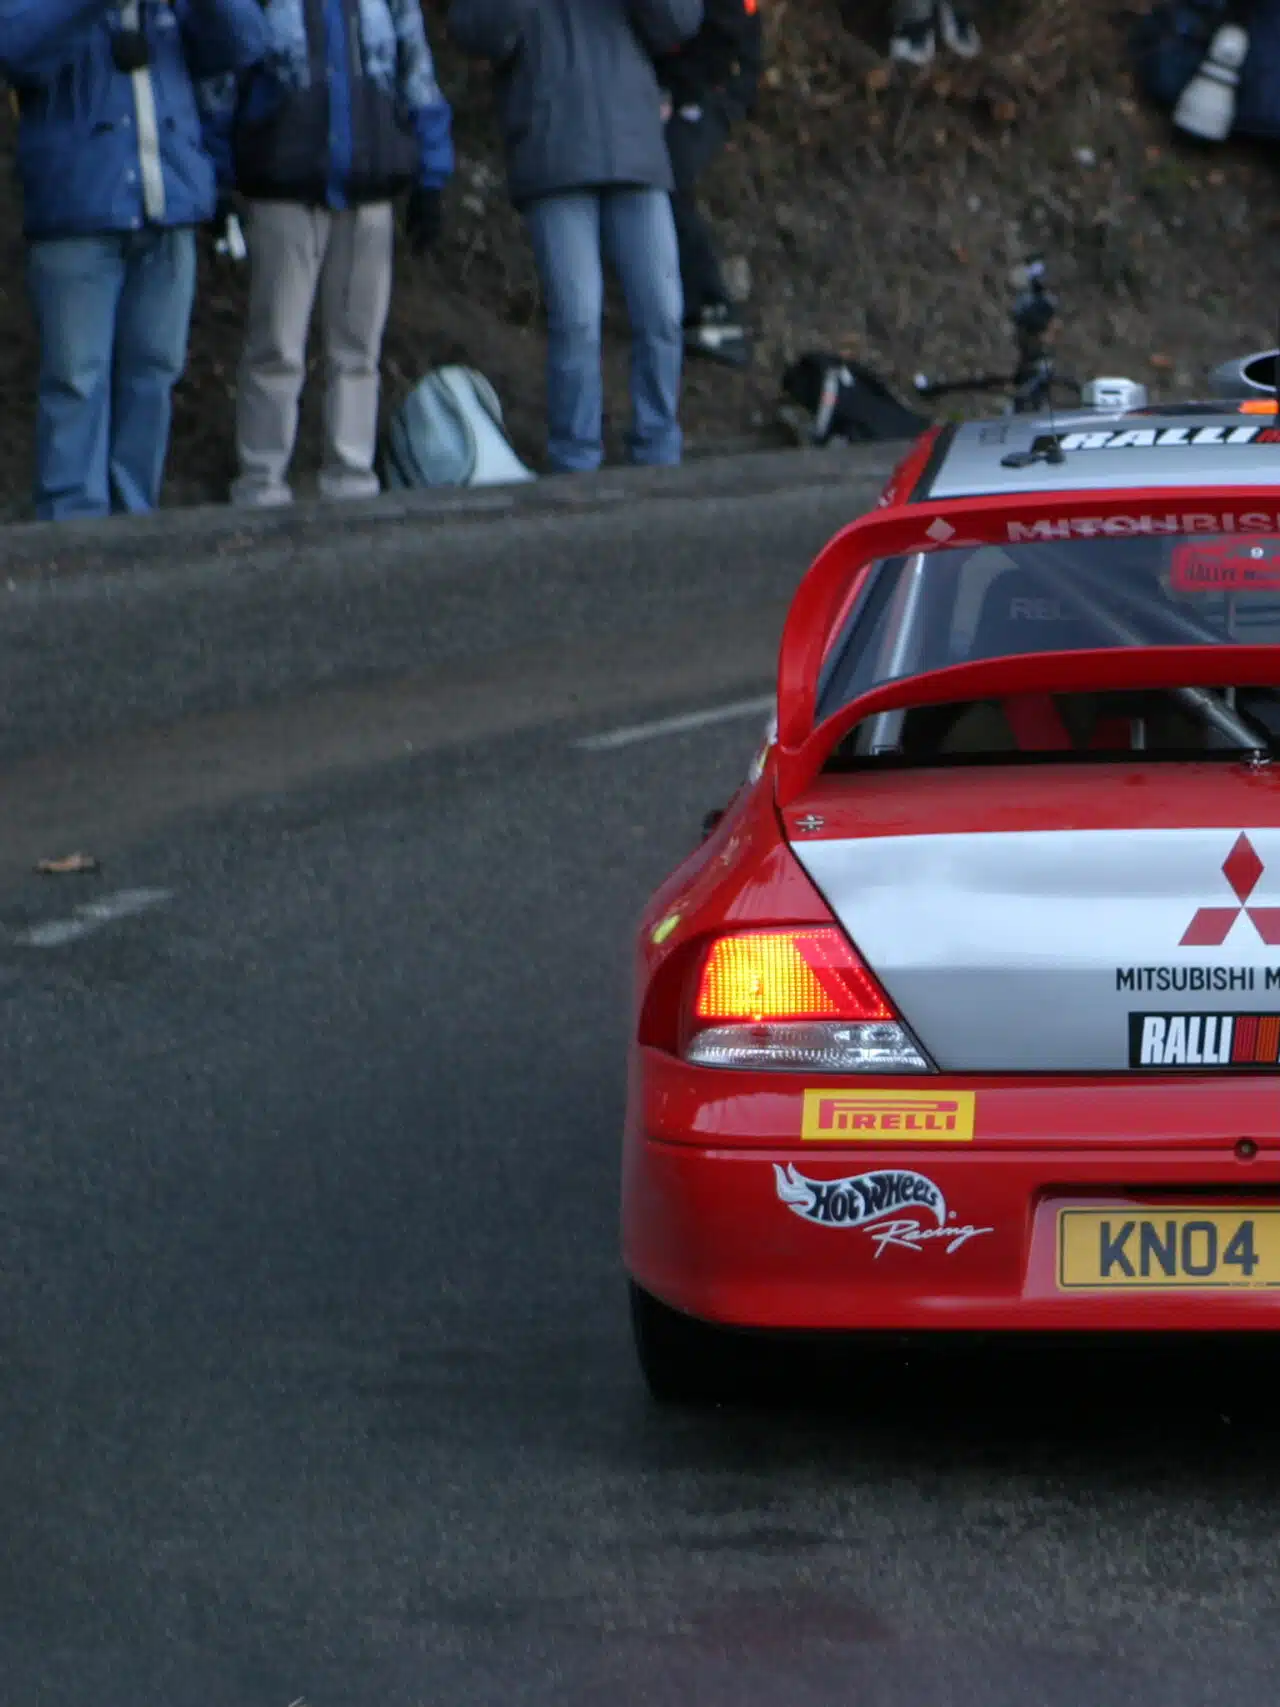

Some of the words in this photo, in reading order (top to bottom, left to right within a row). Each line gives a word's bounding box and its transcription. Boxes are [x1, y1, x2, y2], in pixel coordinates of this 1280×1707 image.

[1060, 426, 1260, 450] RALLI
[1116, 966, 1255, 991] MITSUBISHI
[1140, 1016, 1234, 1065] RALLI
[818, 1099, 959, 1130] PIRELLI
[863, 1219, 994, 1259] Racing
[1100, 1220, 1259, 1277] KN04
